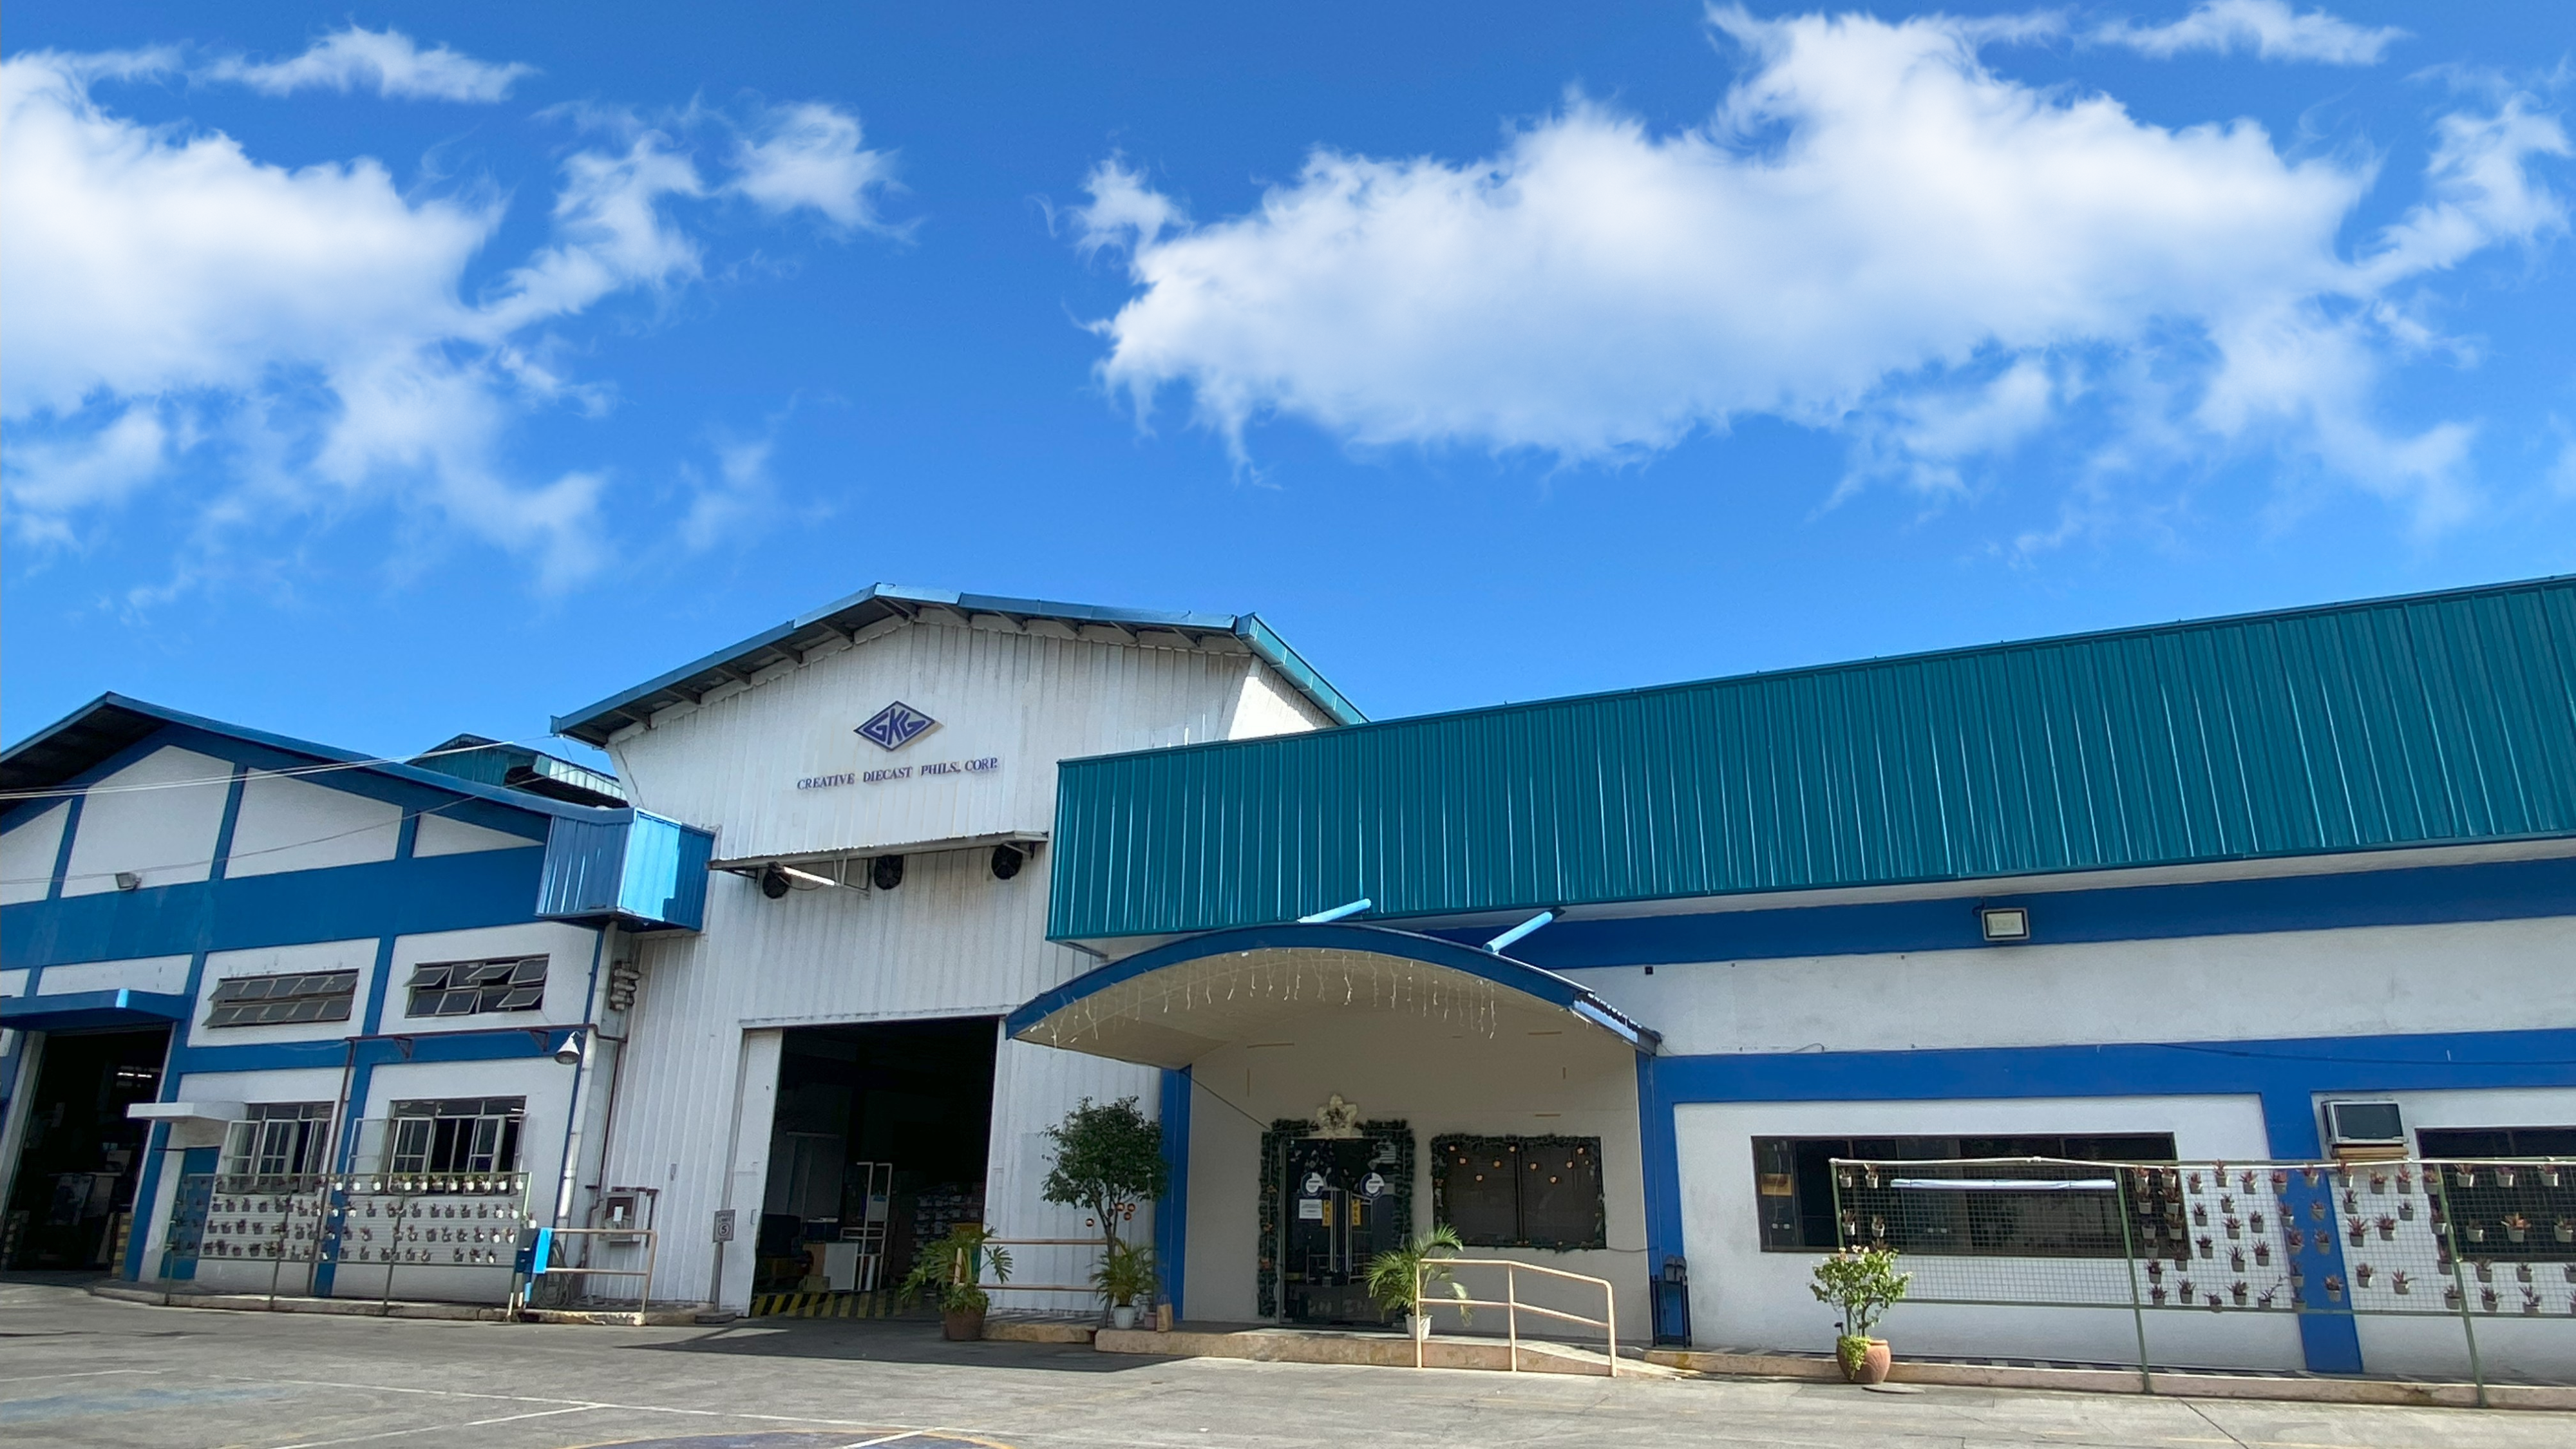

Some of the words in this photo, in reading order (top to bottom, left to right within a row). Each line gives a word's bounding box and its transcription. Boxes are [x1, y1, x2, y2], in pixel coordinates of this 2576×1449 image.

[863, 708, 926, 745] GKG
[797, 773, 855, 790] CREATIVE
[863, 768, 913, 782] DIECAST
[965, 757, 998, 772] CORP.
